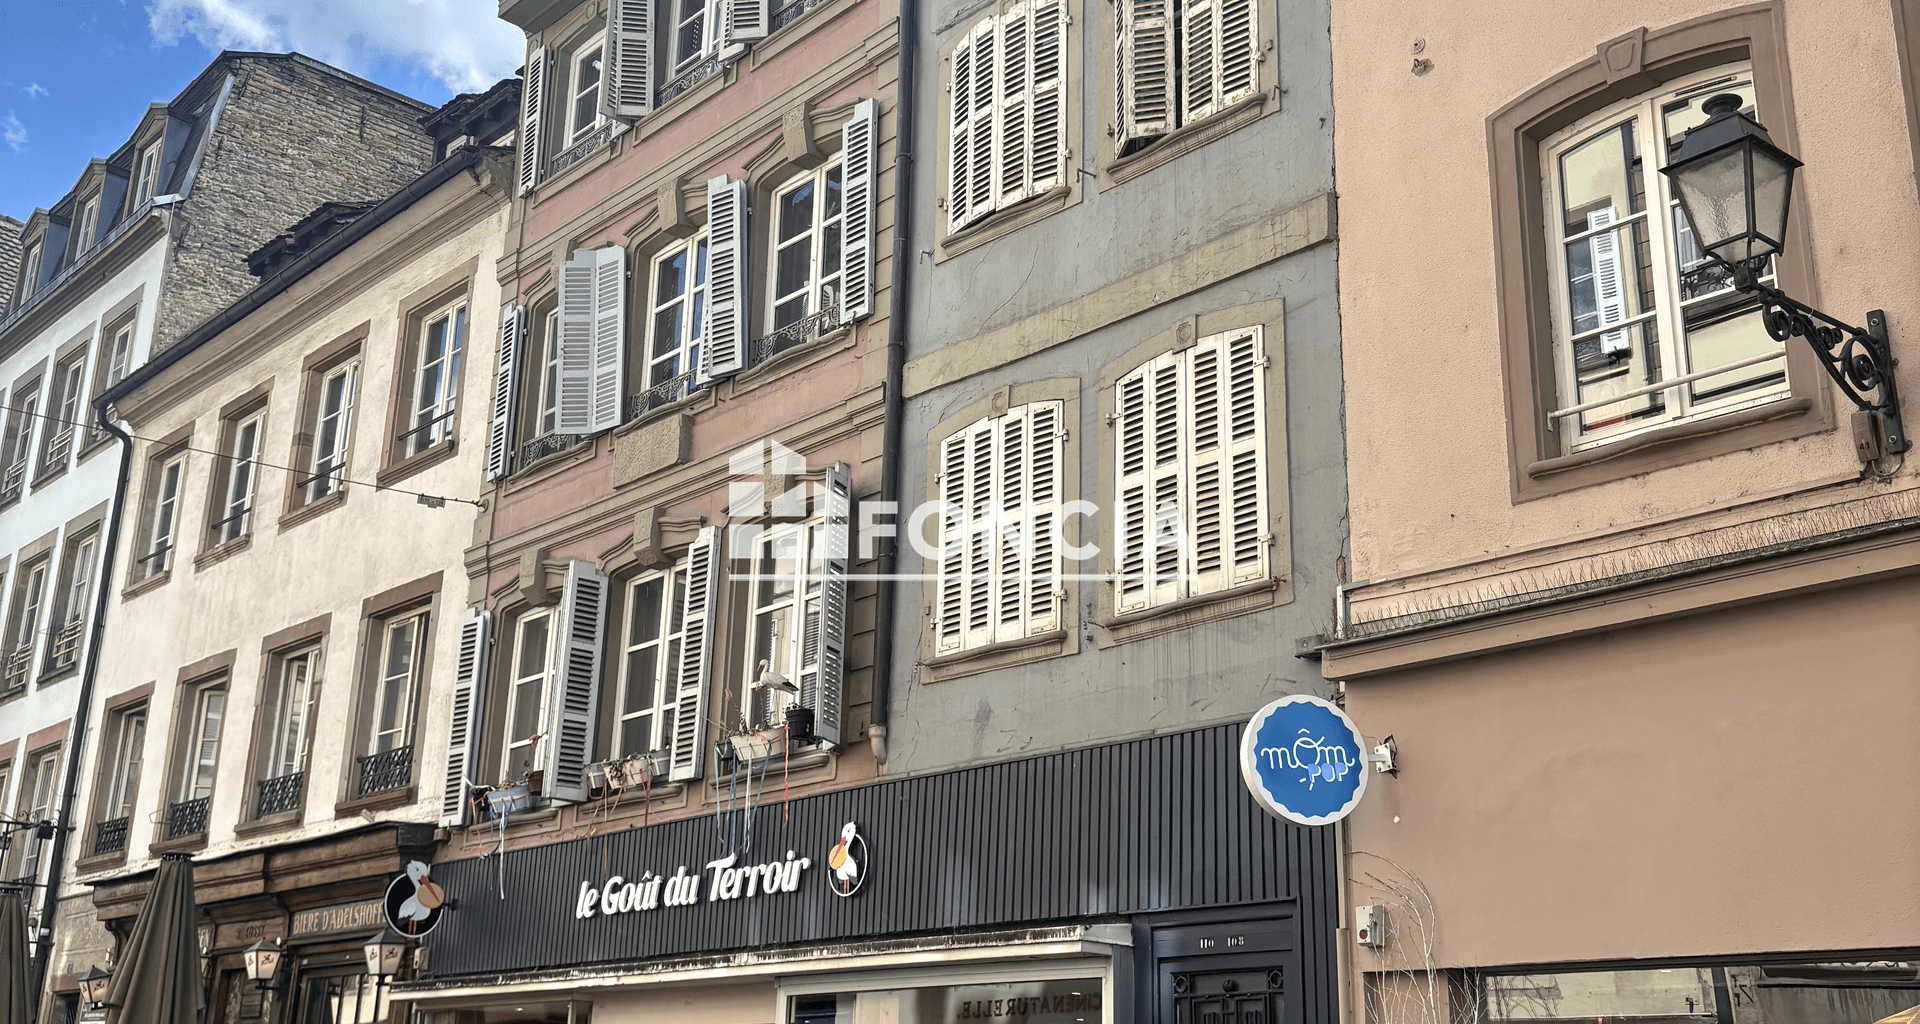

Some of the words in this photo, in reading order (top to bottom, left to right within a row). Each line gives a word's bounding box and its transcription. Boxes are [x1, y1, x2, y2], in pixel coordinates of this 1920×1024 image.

[1859, 441, 1870, 450] 41
[576, 880, 600, 919] le
[601, 870, 664, 916] Goût
[664, 866, 700, 908] du
[706, 850, 812, 902] Terroir
[321, 901, 386, 931] D'ADELSHOFF
[1227, 936, 1245, 947] 108
